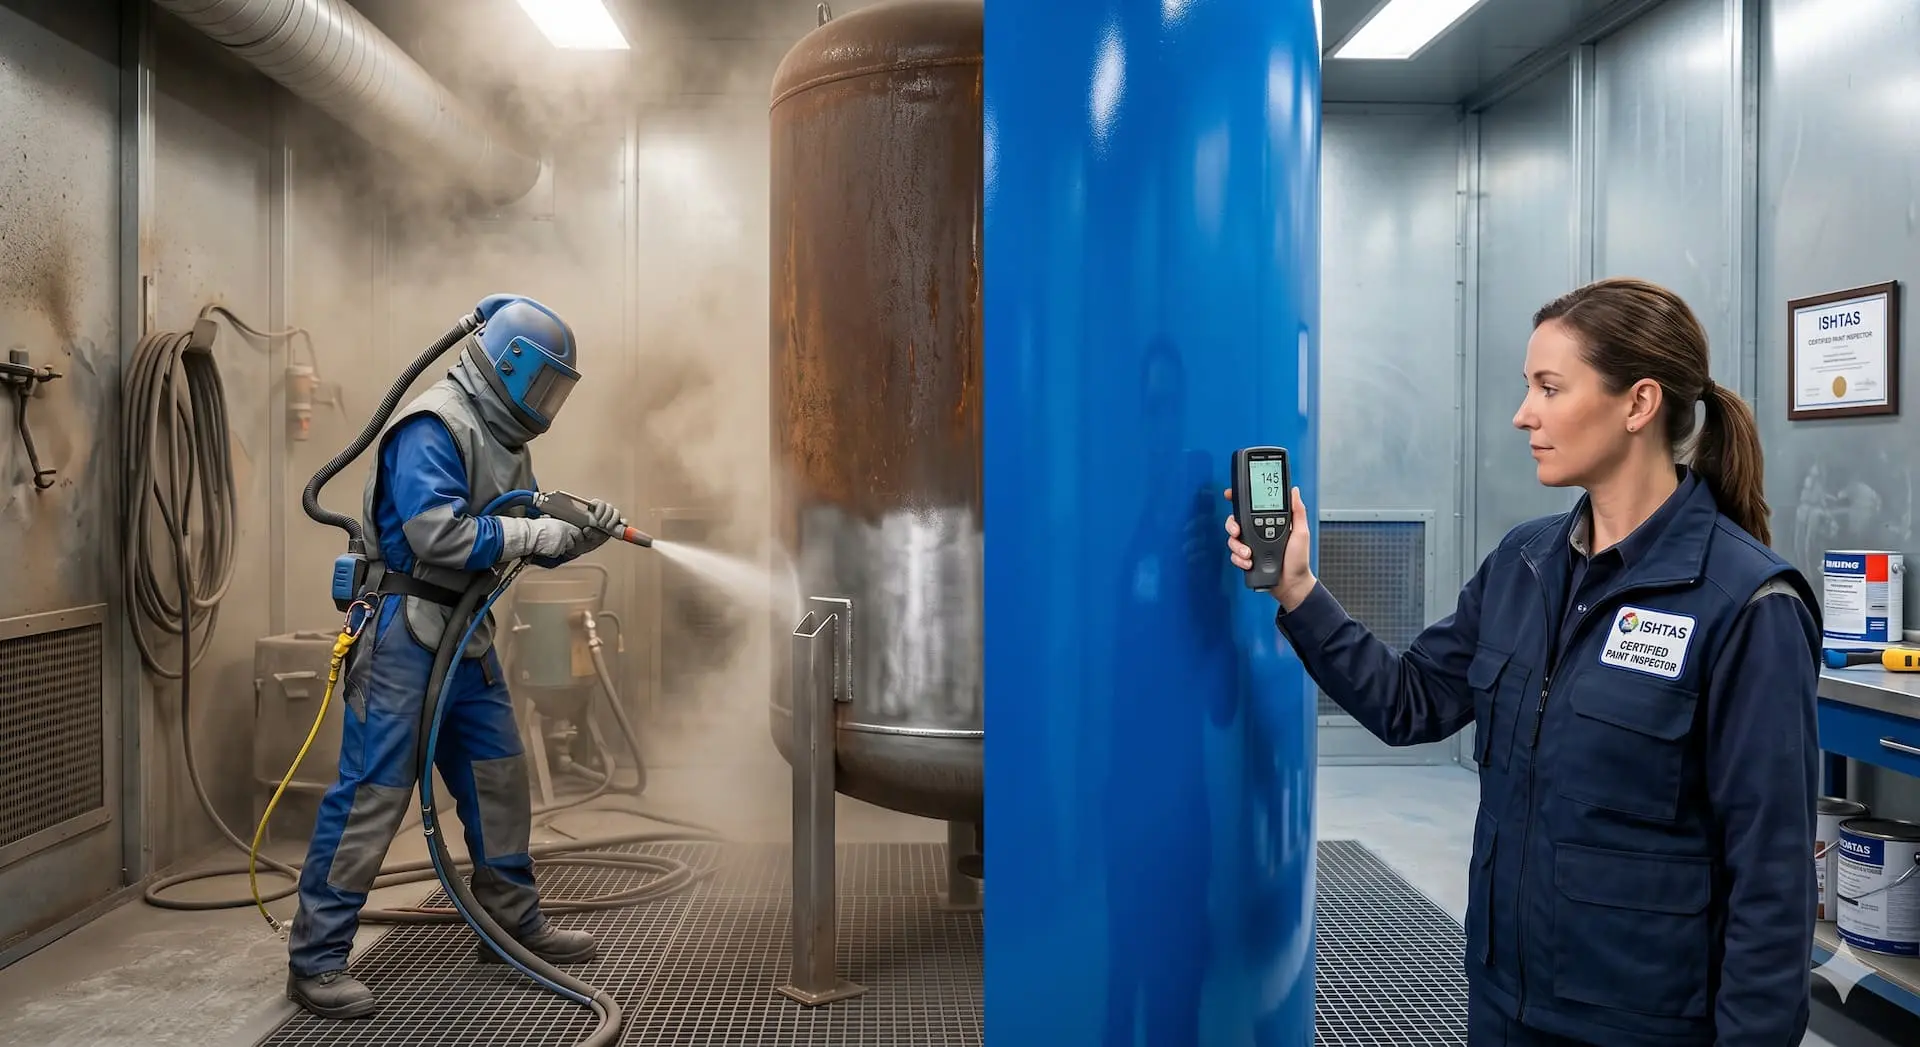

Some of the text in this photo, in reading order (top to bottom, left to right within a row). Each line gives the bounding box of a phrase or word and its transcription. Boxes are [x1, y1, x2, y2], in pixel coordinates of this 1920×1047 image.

[1818, 311, 1861, 330] ISHTAS
[1808, 336, 1832, 346] CERTIFIED
[1846, 331, 1873, 341] INSPECTOR
[1261, 472, 1280, 484] 145
[1267, 486, 1279, 497] 27
[1639, 621, 1688, 639] ISHTAS
[1620, 640, 1669, 658] CERTIFIED
[1605, 649, 1677, 672] PAINT INSPECTOR
